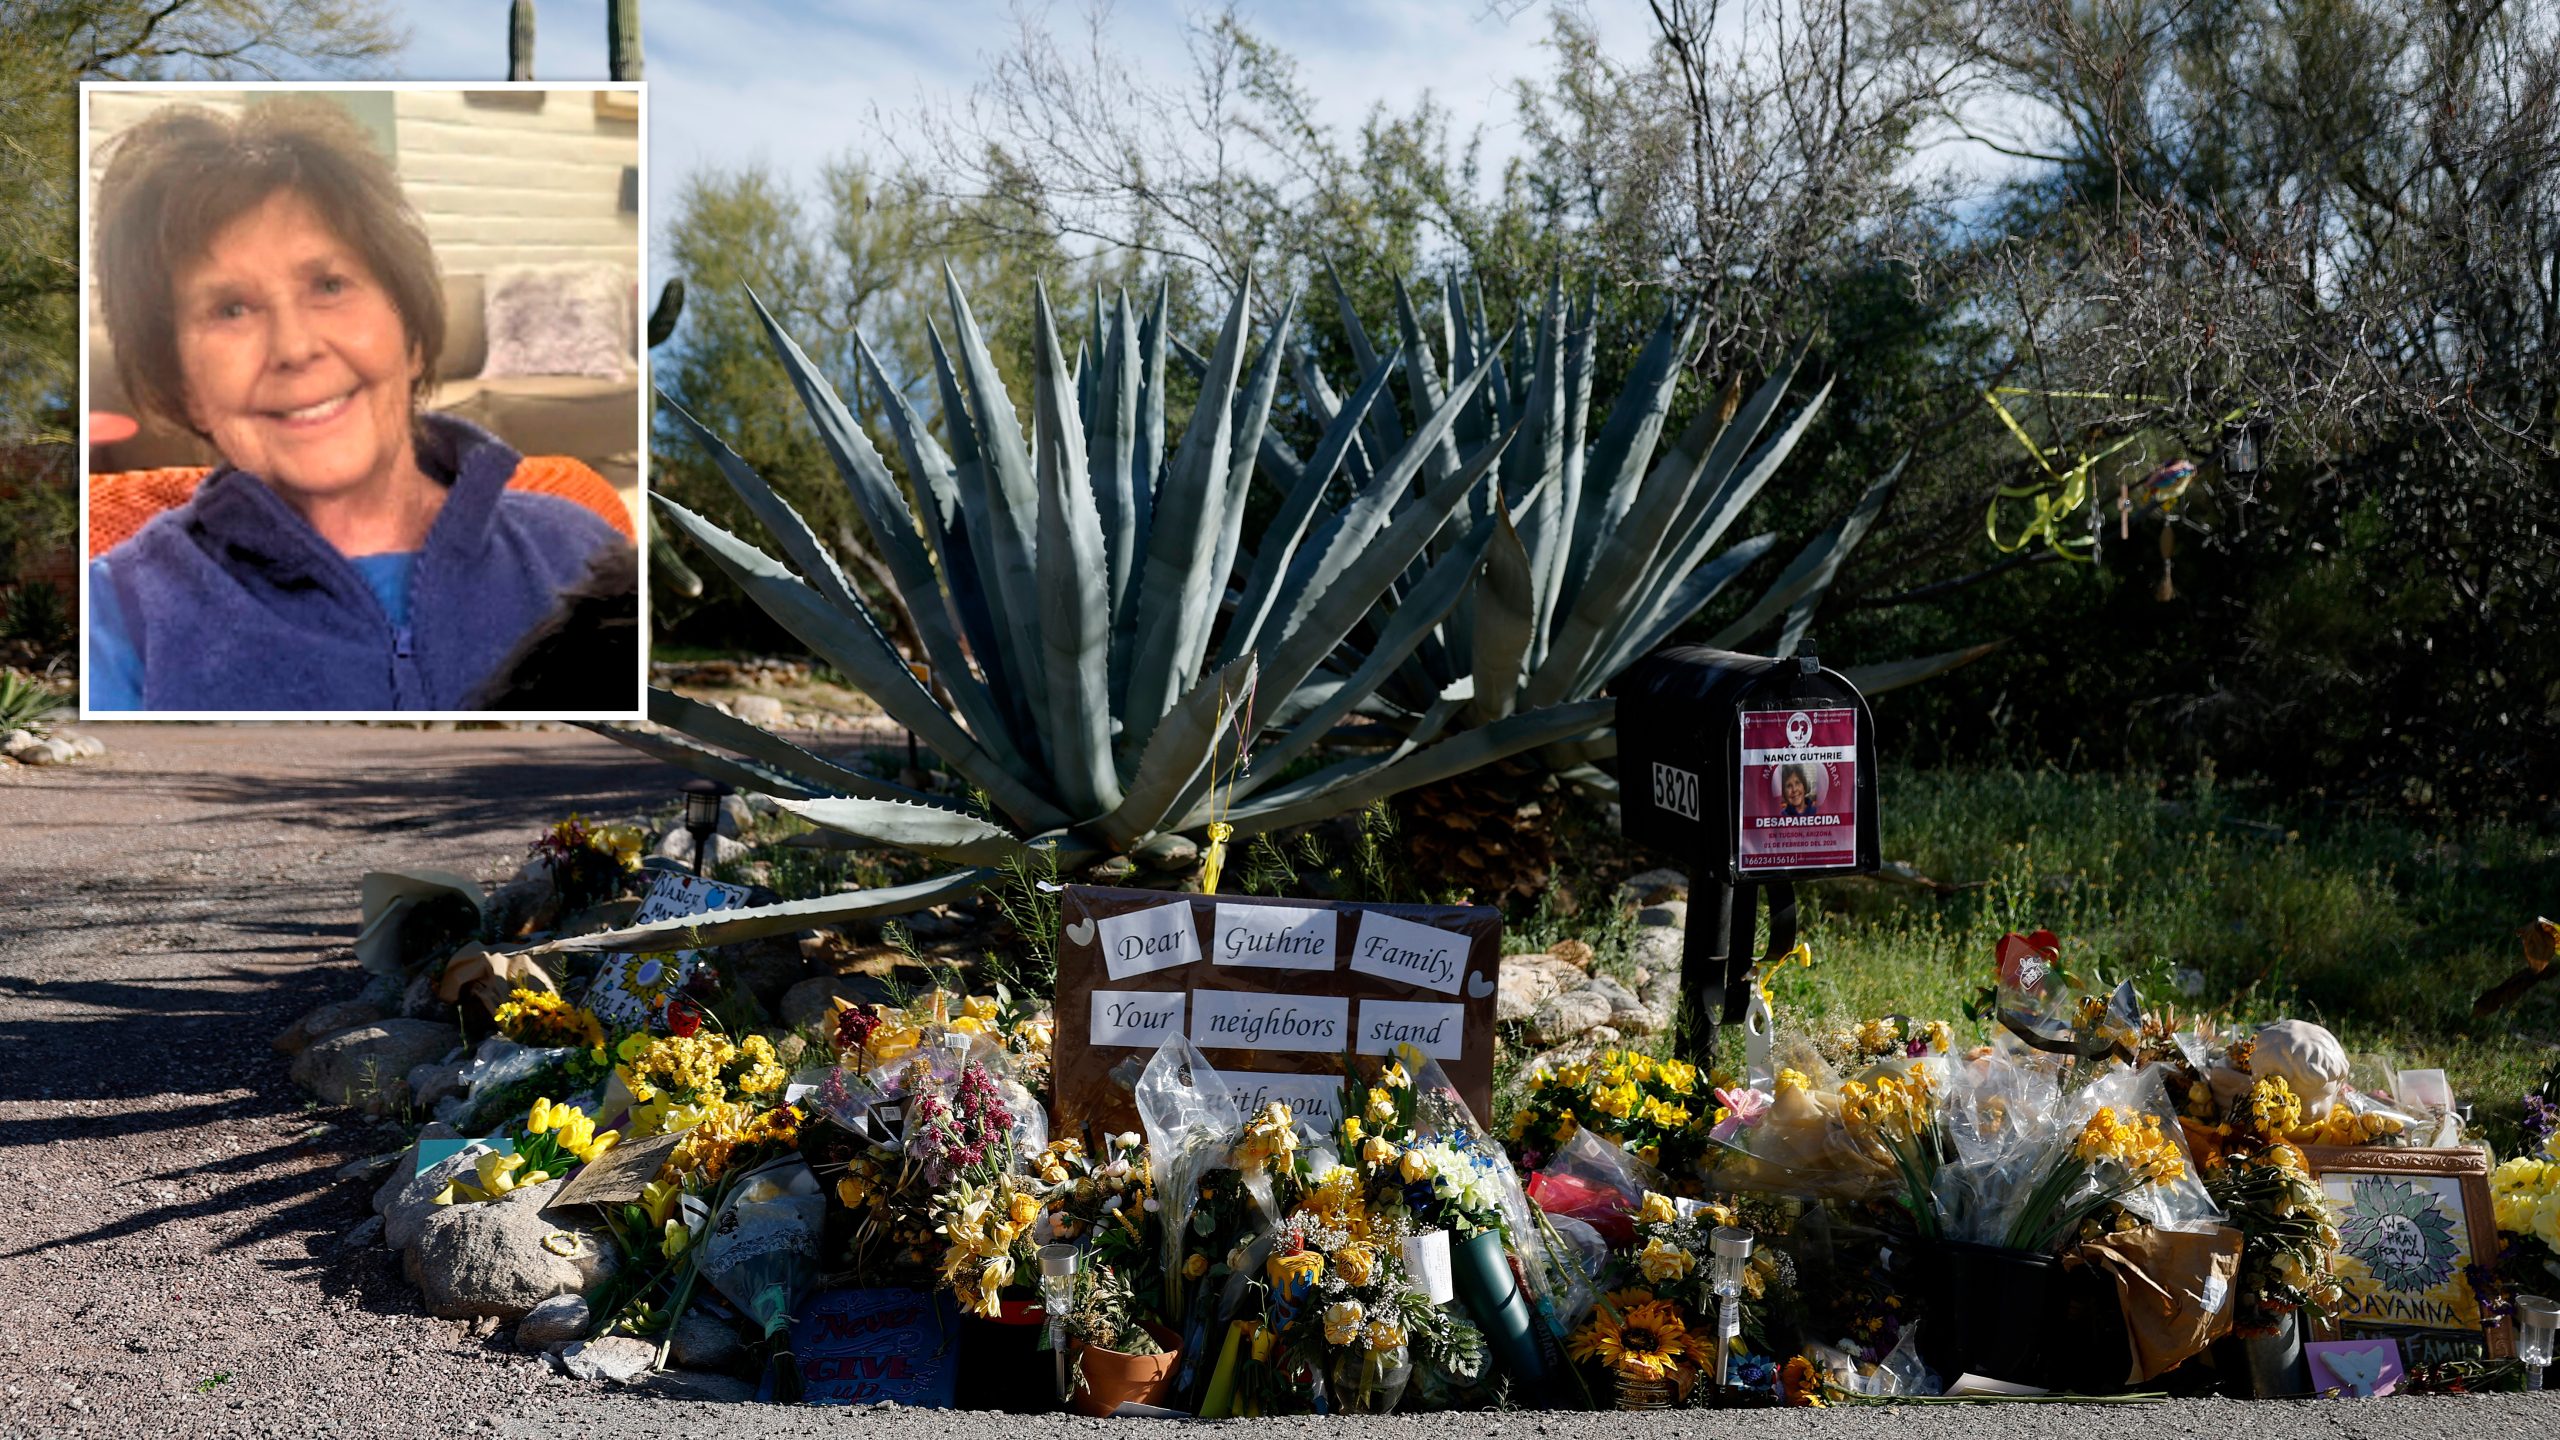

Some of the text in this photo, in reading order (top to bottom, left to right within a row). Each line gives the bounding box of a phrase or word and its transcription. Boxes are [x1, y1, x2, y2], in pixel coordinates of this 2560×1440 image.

[1763, 751, 1842, 763] NANCY GUTHRIE
[1655, 764, 1698, 818] 5820
[1755, 815, 1841, 828] DESAPARECIDA
[1117, 926, 1454, 984] Dear Guthrie Family,
[1106, 1001, 1450, 1044] Your neighbors stand
[2386, 1231, 2417, 1250] PRAY
[803, 1354, 914, 1382] GIVE
